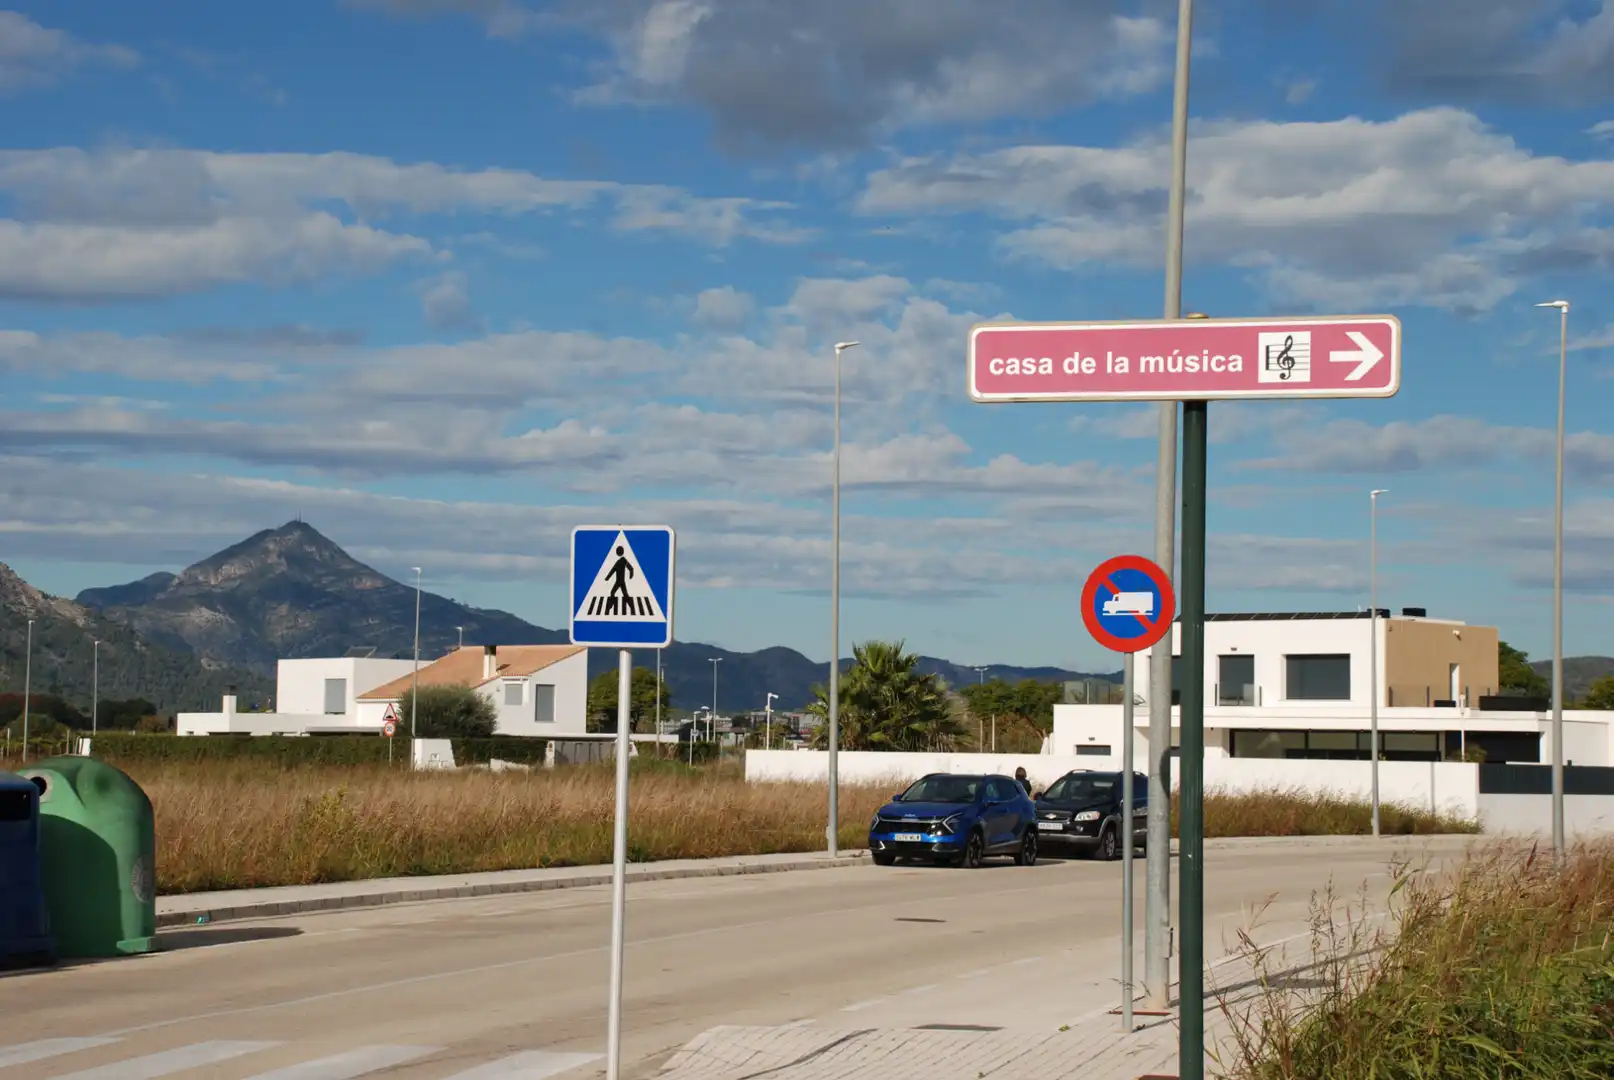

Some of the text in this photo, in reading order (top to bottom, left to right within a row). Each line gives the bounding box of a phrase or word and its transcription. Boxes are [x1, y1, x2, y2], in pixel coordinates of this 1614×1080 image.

[988, 348, 1244, 376] casa de la música
